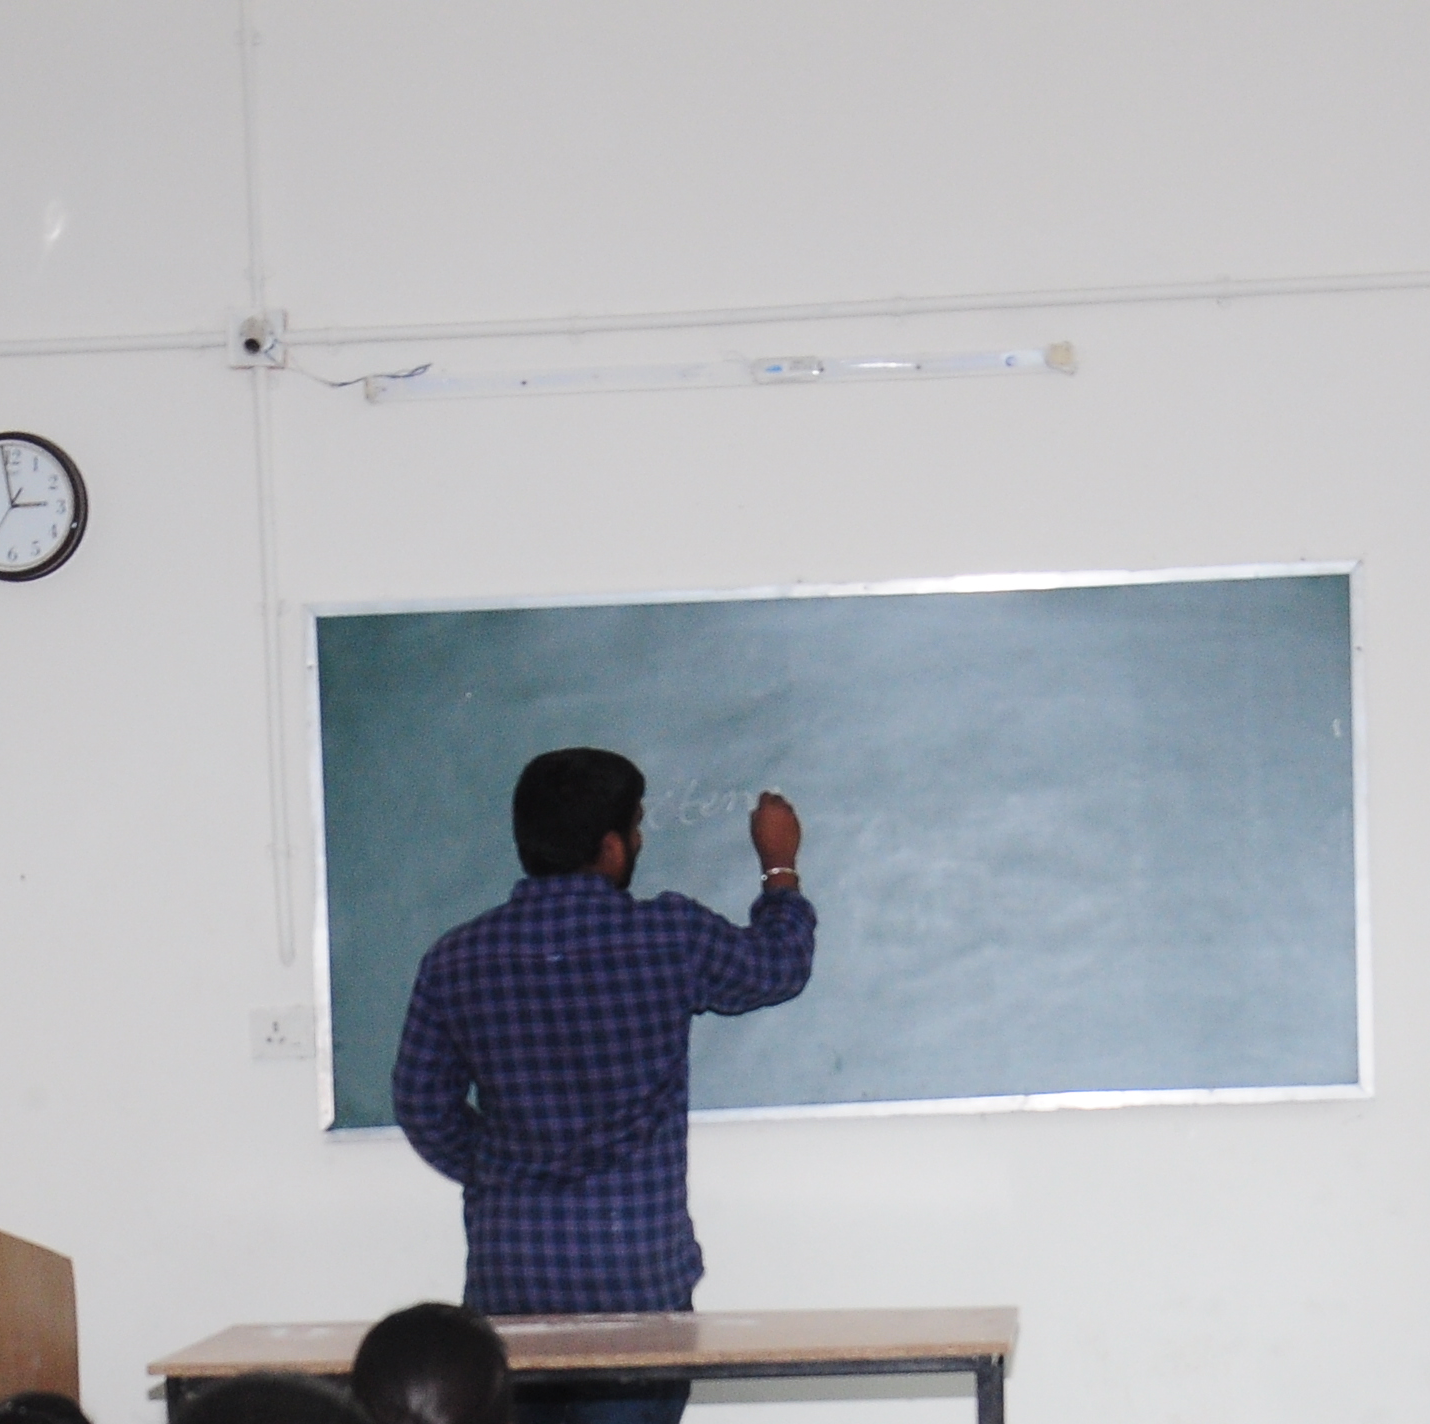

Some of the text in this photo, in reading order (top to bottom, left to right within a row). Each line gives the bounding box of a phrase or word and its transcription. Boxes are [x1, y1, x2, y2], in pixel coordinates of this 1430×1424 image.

[32, 456, 39, 472] 1
[48, 474, 58, 490] 2
[56, 499, 67, 515] 3
[49, 523, 58, 539] 4
[7, 545, 18, 561] 6
[31, 540, 41, 556] 5
